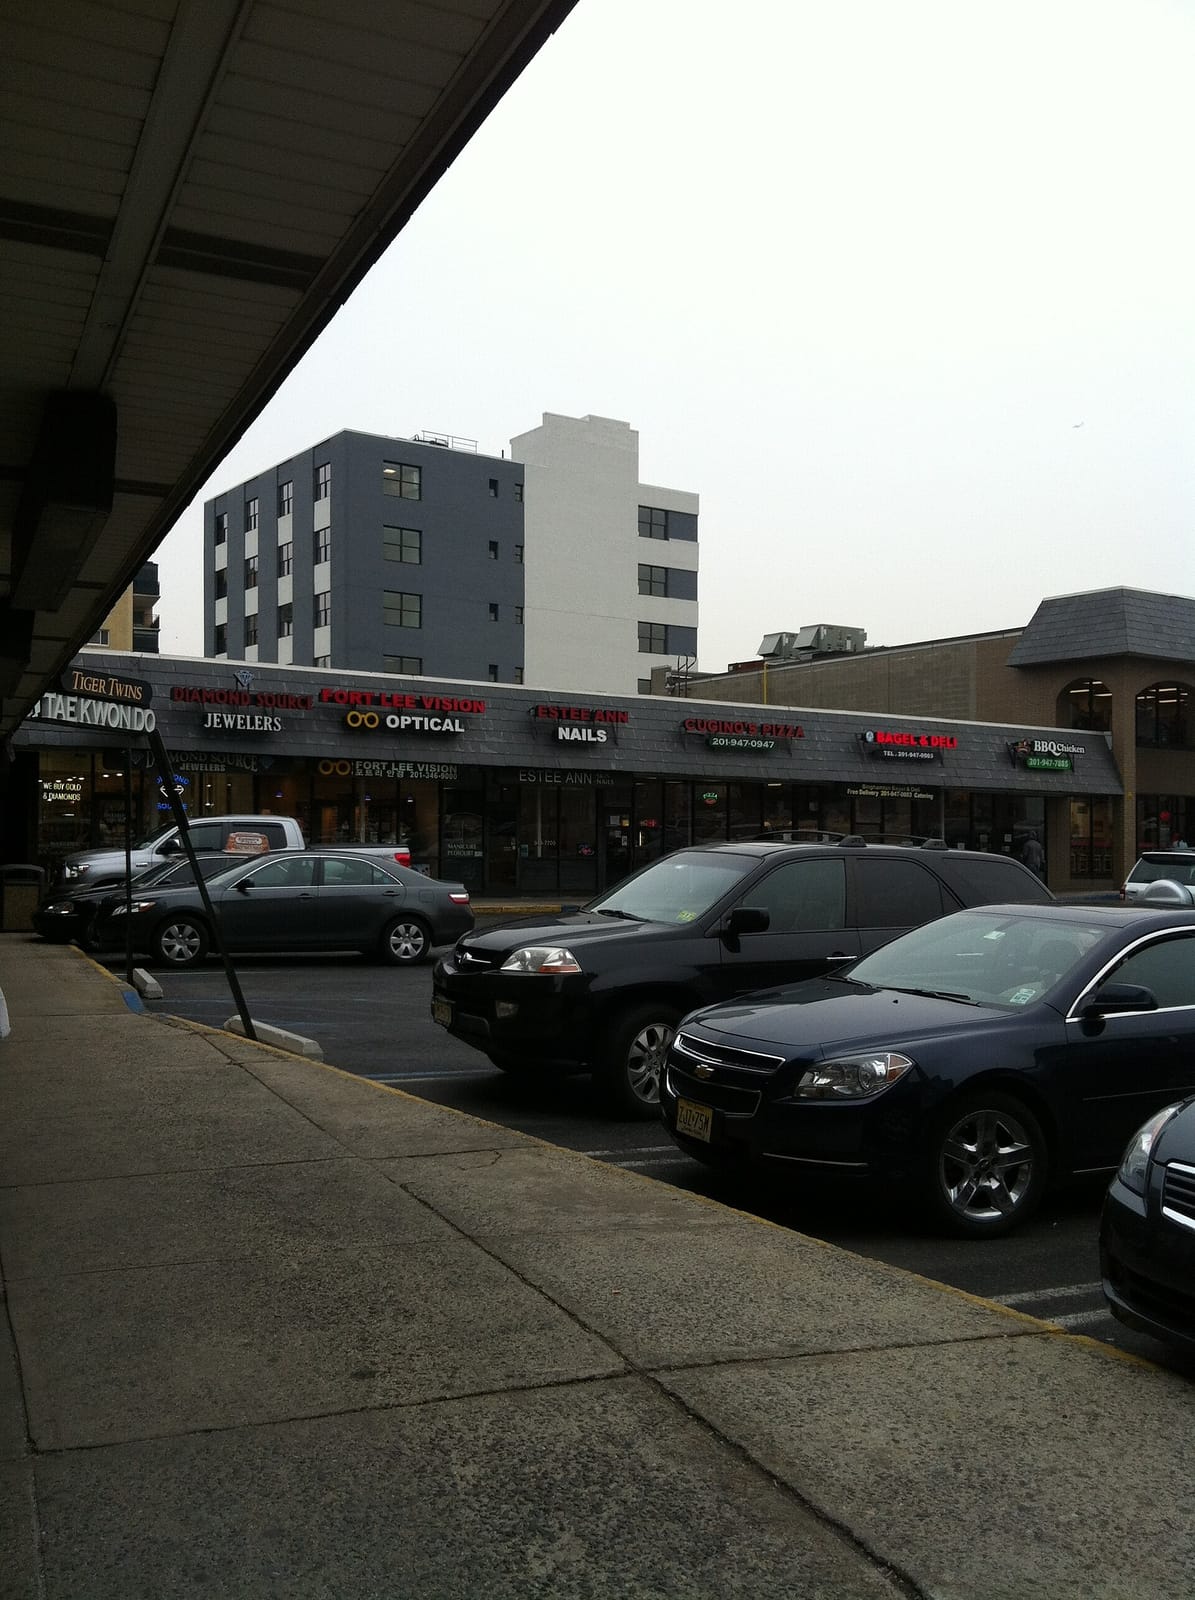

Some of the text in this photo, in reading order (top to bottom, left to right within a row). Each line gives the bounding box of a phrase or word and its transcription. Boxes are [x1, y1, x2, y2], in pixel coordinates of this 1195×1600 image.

[72, 671, 143, 700] TIGER TWINS
[172, 687, 314, 710] DIAMOND SOURCE
[320, 688, 486, 713] FORT LEE VISION
[43, 692, 156, 733] TAEKWONDO
[537, 705, 629, 723] ESTEE ANN
[203, 713, 282, 732] JEWELERS
[385, 714, 465, 733] OPTICAL
[684, 718, 805, 738] CUGINO'S PIZZA
[557, 727, 608, 743] NAILS
[712, 737, 775, 749] 201-947-0947
[876, 731, 958, 749] BAGEL & DELI
[1034, 740, 1086, 756] BBQ Chicken
[180, 763, 226, 772] JEWELERS
[210, 753, 258, 772] SOURCE
[355, 761, 458, 774] FORT LEE VISION
[519, 769, 562, 783] ESTEE
[565, 771, 592, 784] ANN
[43, 782, 81, 791] WE BUY GOLD
[859, 789, 879, 797] Delivery
[48, 792, 81, 800] DIAMONDS
